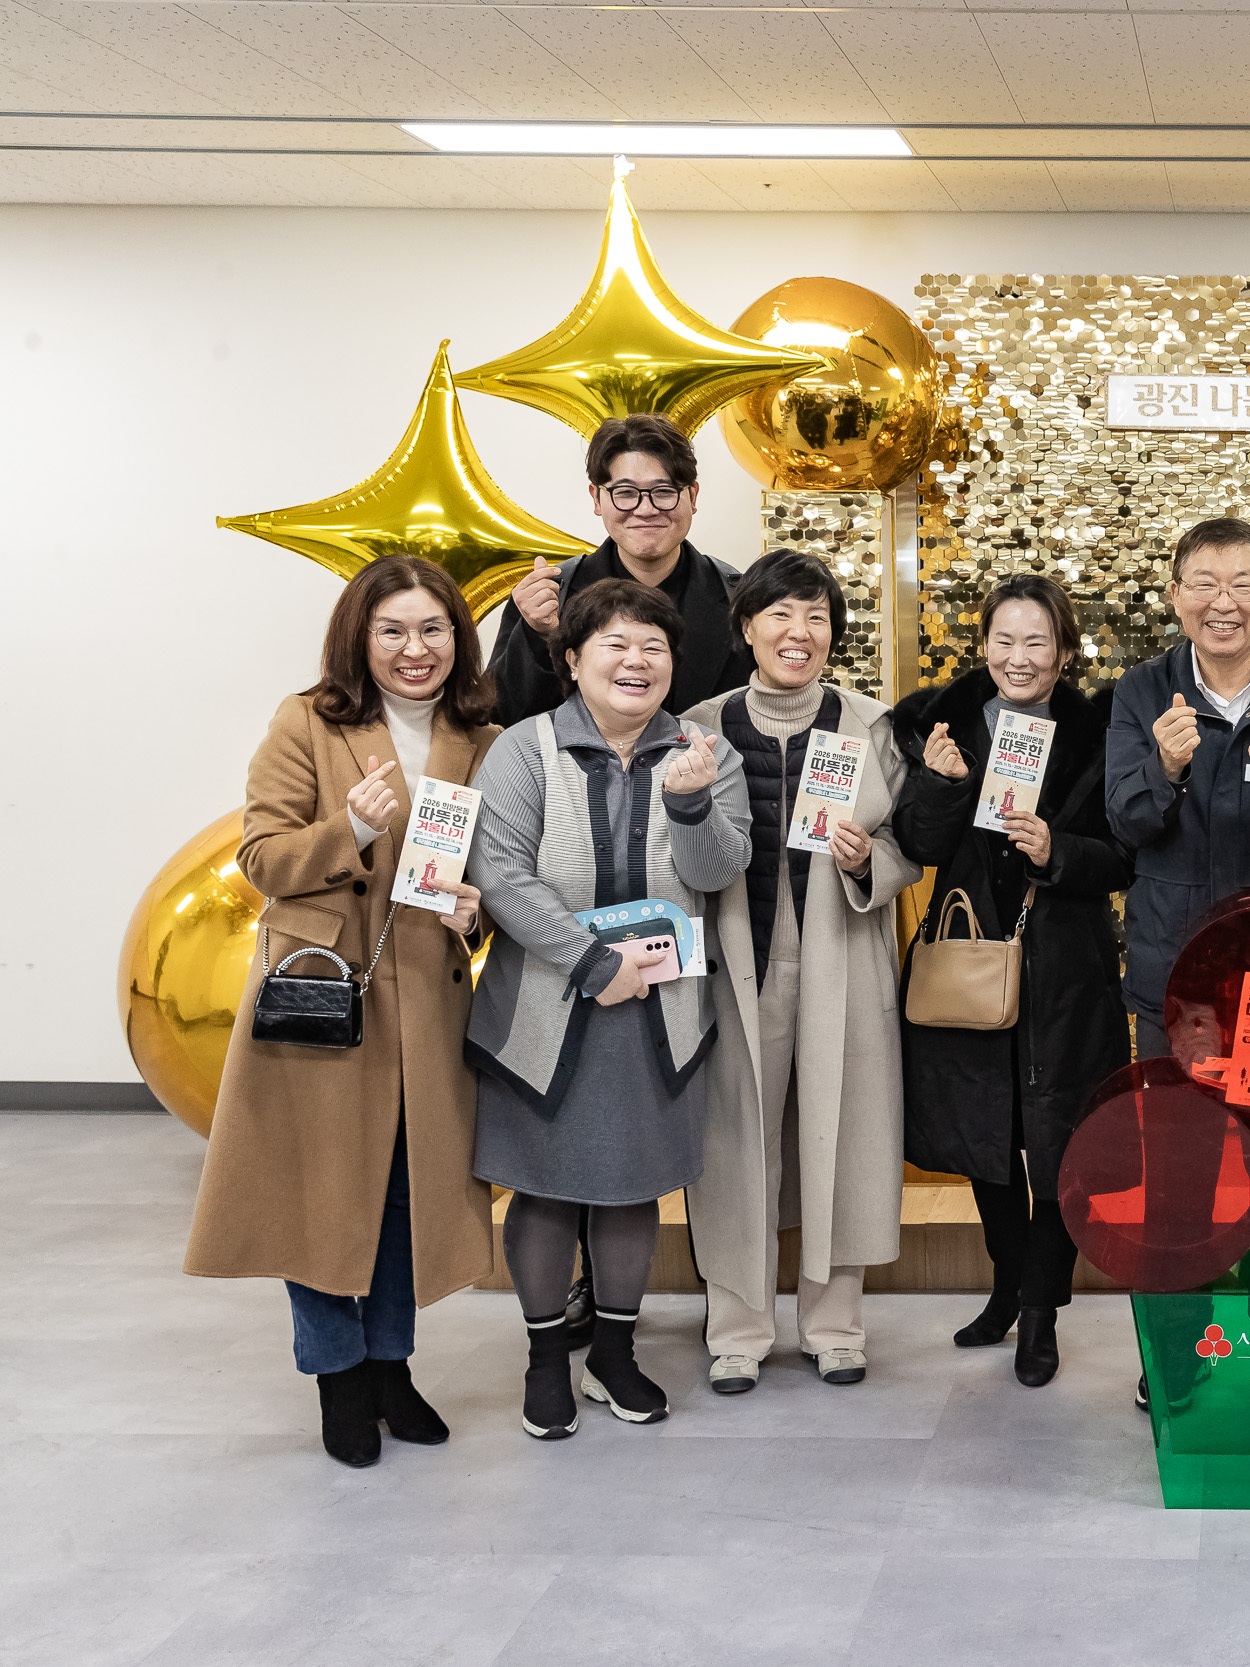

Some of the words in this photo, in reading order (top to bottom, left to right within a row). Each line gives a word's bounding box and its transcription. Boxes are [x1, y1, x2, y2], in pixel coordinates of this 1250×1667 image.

[1132, 383, 1198, 417] 광진
[1002, 730, 1018, 738] 2026
[814, 750, 830, 758] 2026
[998, 738, 1043, 758] 따뜻한
[810, 757, 856, 777] 따뜻한
[996, 750, 1039, 768] 겨울나기
[808, 771, 852, 787] 겨울나기
[422, 798, 440, 807] 2026
[418, 806, 468, 829] 따뜻한
[416, 820, 464, 839] 겨울나기
